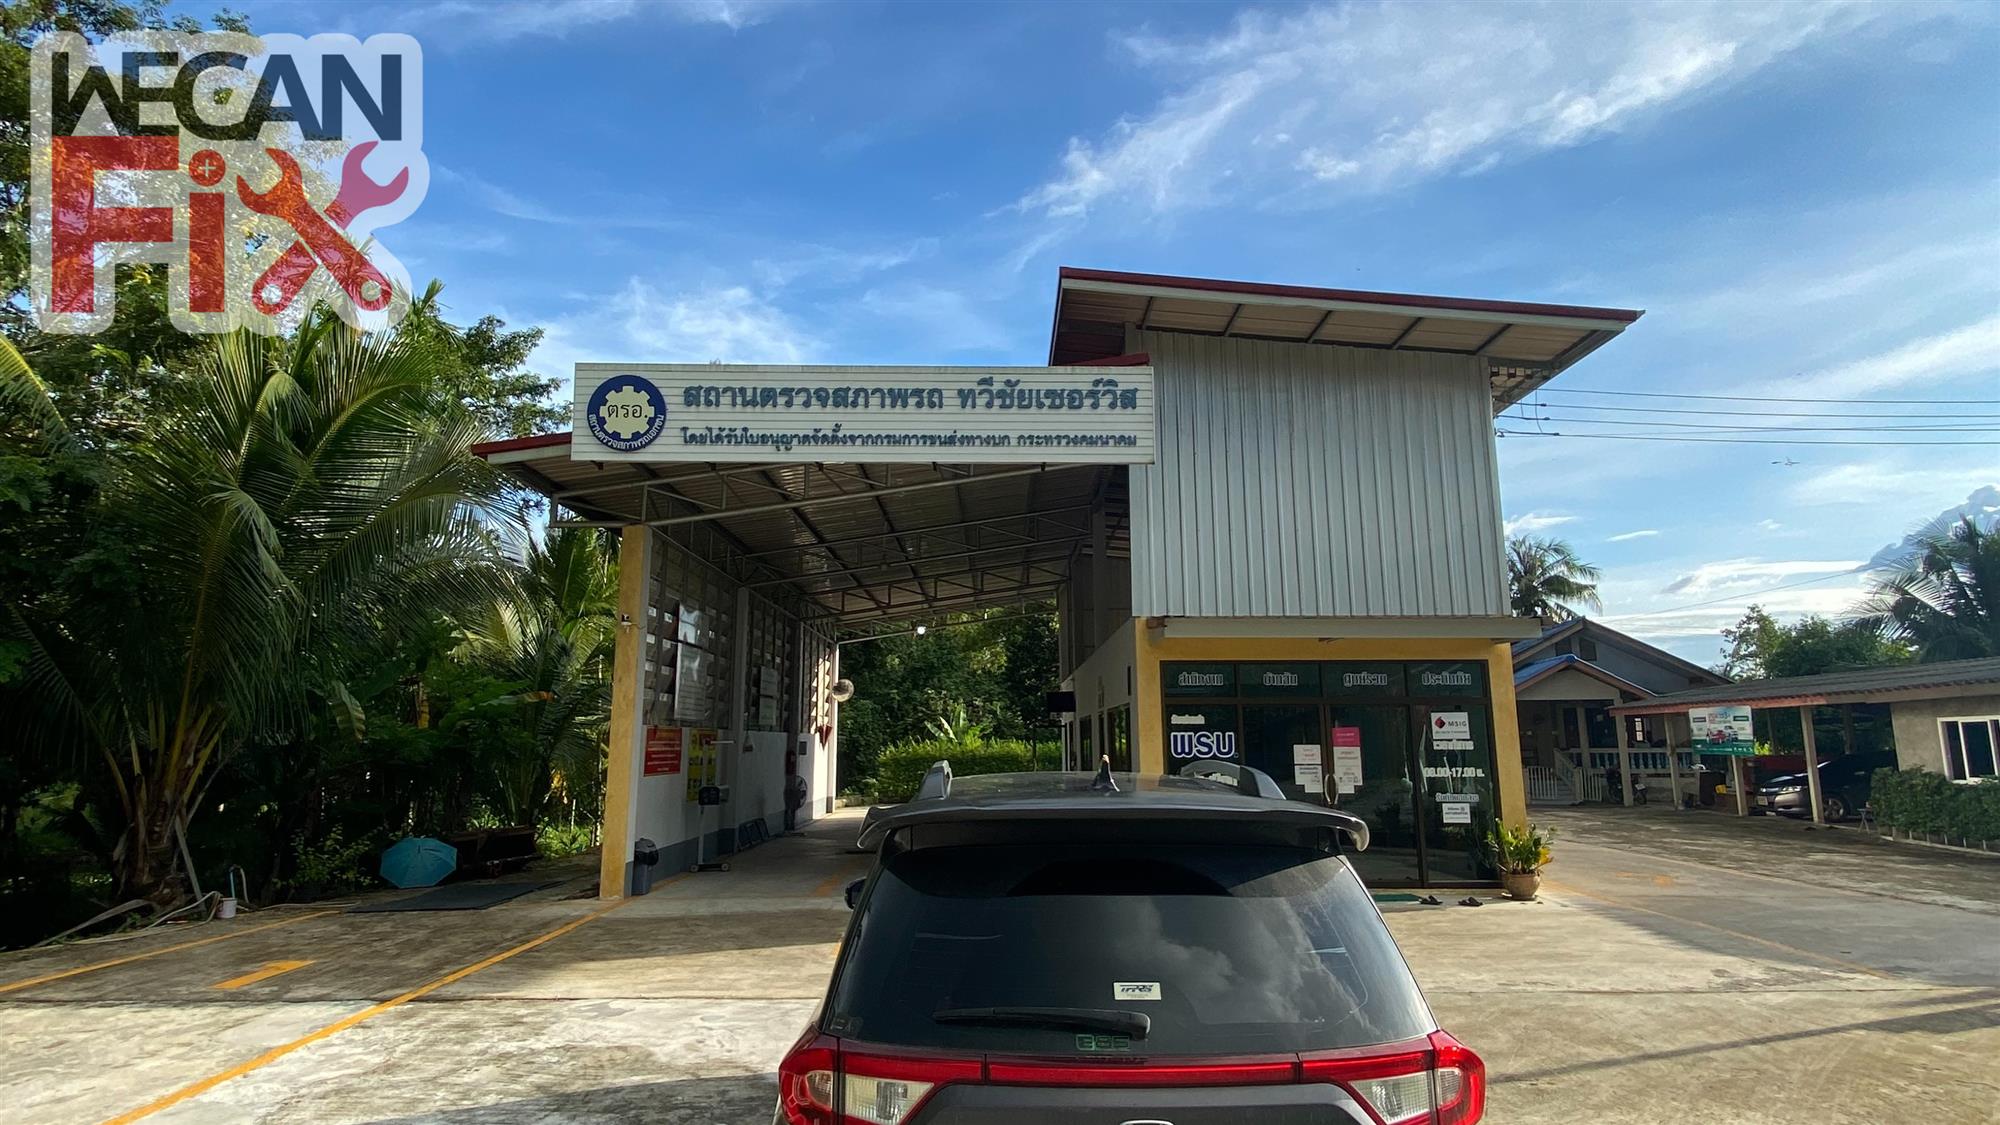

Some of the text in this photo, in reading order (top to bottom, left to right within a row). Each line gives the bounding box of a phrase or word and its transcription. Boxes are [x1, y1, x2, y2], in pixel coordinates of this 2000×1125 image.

[683, 385, 944, 409] สถานตรวจสภาพรถ
[607, 404, 648, 418] ตรอ.
[1017, 434, 1137, 447] กระทรวงคมนาคม
